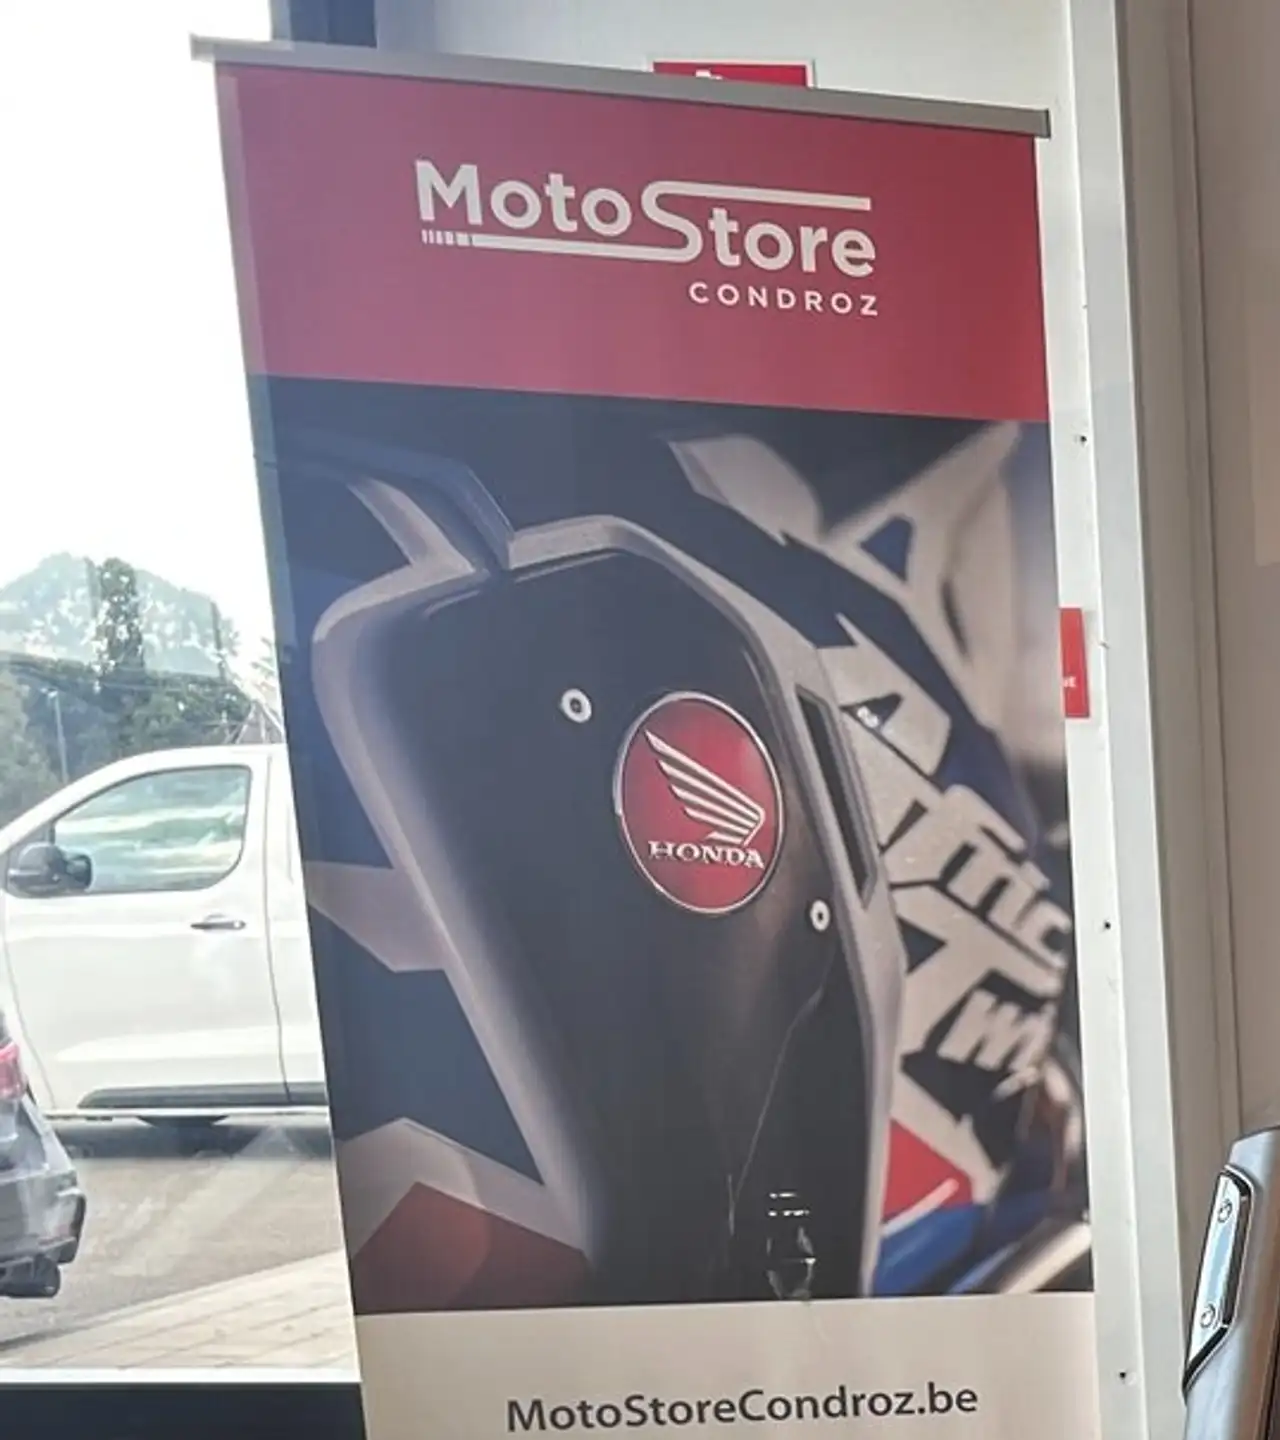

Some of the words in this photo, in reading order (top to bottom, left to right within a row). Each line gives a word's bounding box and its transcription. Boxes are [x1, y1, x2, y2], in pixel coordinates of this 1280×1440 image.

[415, 160, 877, 277] MotoStore
[689, 281, 878, 316] CONDROZ
[647, 839, 765, 870] HONDA
[506, 1380, 979, 1434] MotoStoreCondroz.be
